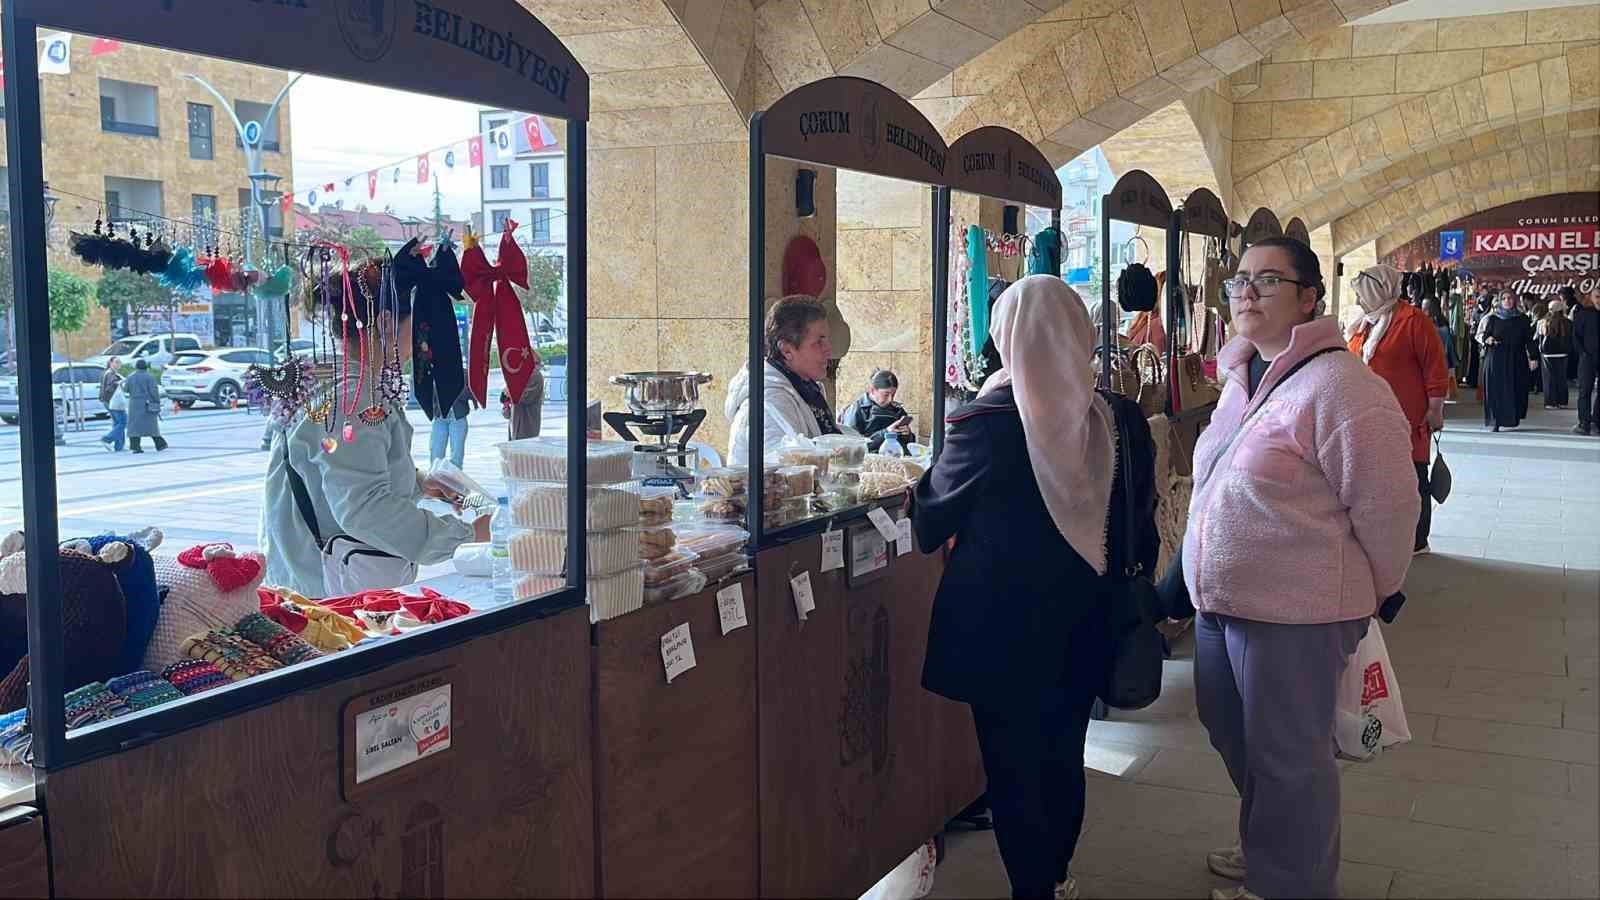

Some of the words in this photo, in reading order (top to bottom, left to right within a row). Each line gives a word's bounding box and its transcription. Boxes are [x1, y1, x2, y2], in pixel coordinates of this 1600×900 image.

[413, 1, 571, 103] BELEDİYESİ
[800, 111, 849, 142] ÇORUM
[886, 122, 945, 177] BELEDİYESİ
[1518, 217, 1557, 227] ÇORUM
[1475, 232, 1555, 252] KADIN
[1560, 231, 1590, 249] EL
[1522, 253, 1600, 277] ÇARŞI
